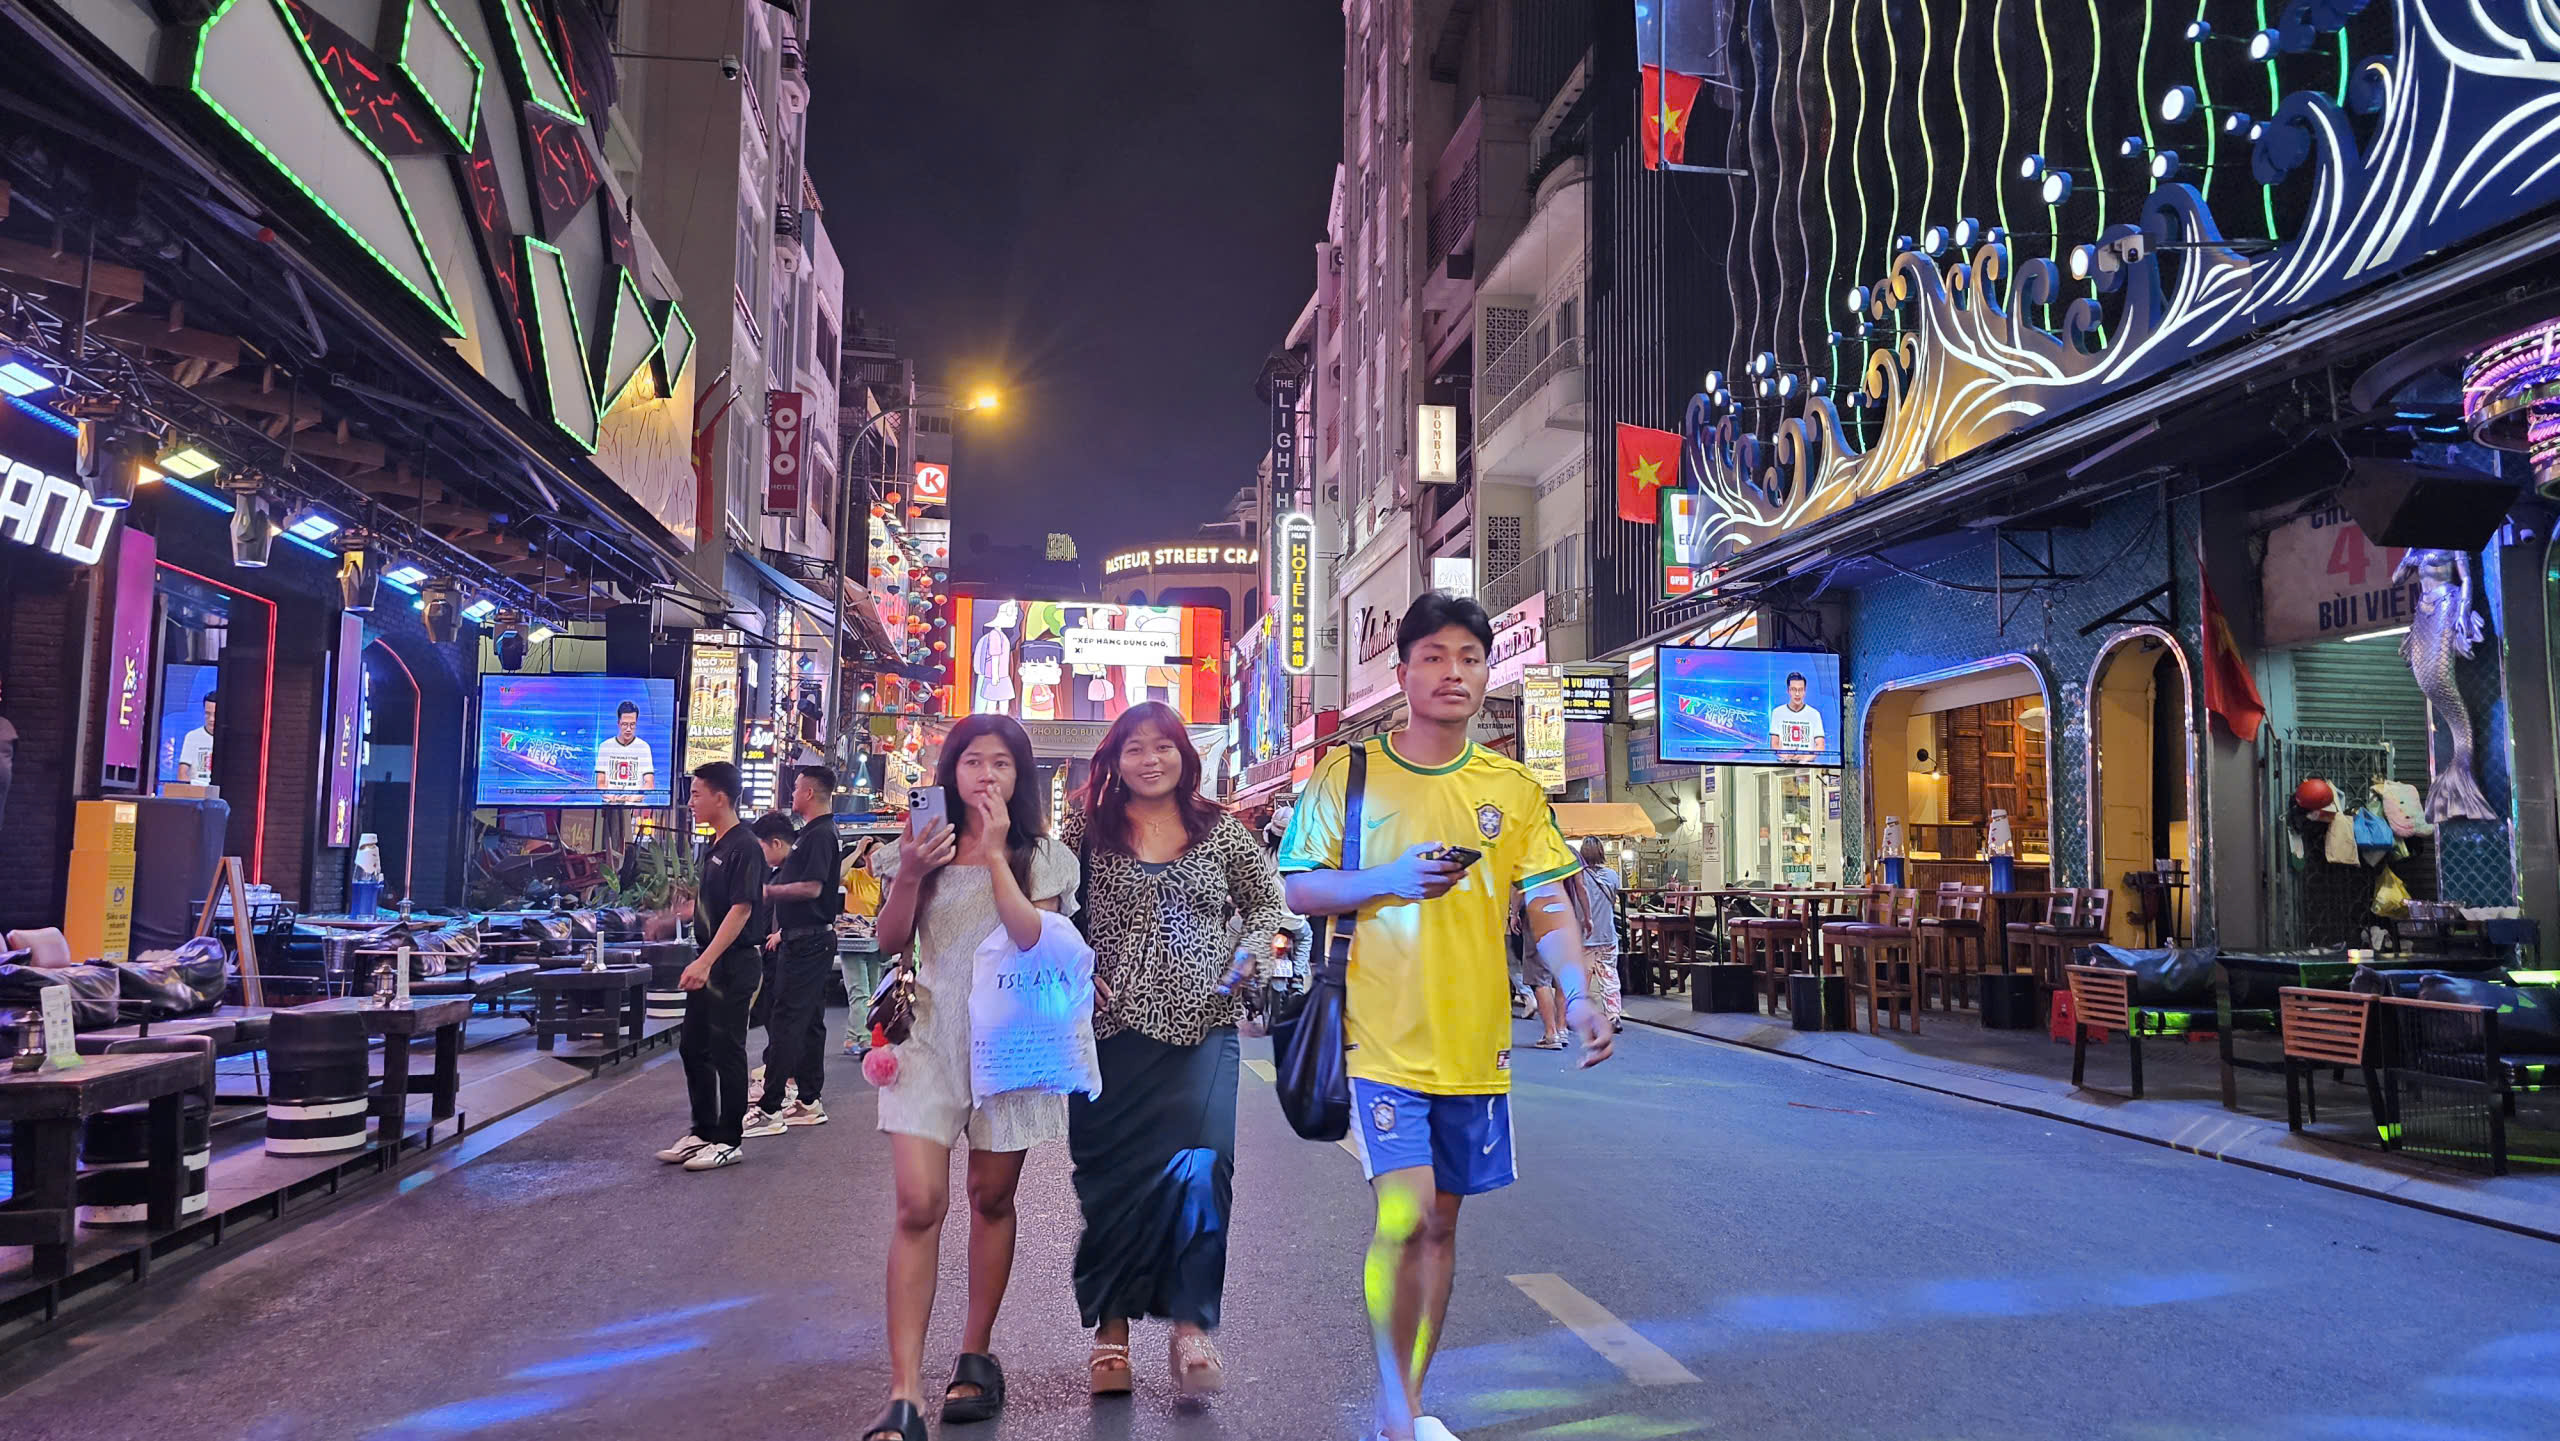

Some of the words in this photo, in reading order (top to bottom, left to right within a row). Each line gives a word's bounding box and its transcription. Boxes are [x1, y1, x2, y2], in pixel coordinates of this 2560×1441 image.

[1275, 380, 1293, 388] THE
[773, 407, 798, 475] OYO
[1433, 409, 1442, 470] BOMBAY
[1105, 551, 1150, 575] PASTEUR
[1154, 548, 1219, 565] STREET
[1291, 544, 1307, 608] HOTEL
[2319, 592, 2358, 631] BÙI
[695, 633, 724, 643] AXE
[1525, 667, 1549, 675] AXE
[1571, 677, 1583, 688] VU
[1584, 678, 1609, 689] HOTEL
[1704, 712, 1734, 729] NEWS
[527, 749, 558, 767] NEWS
